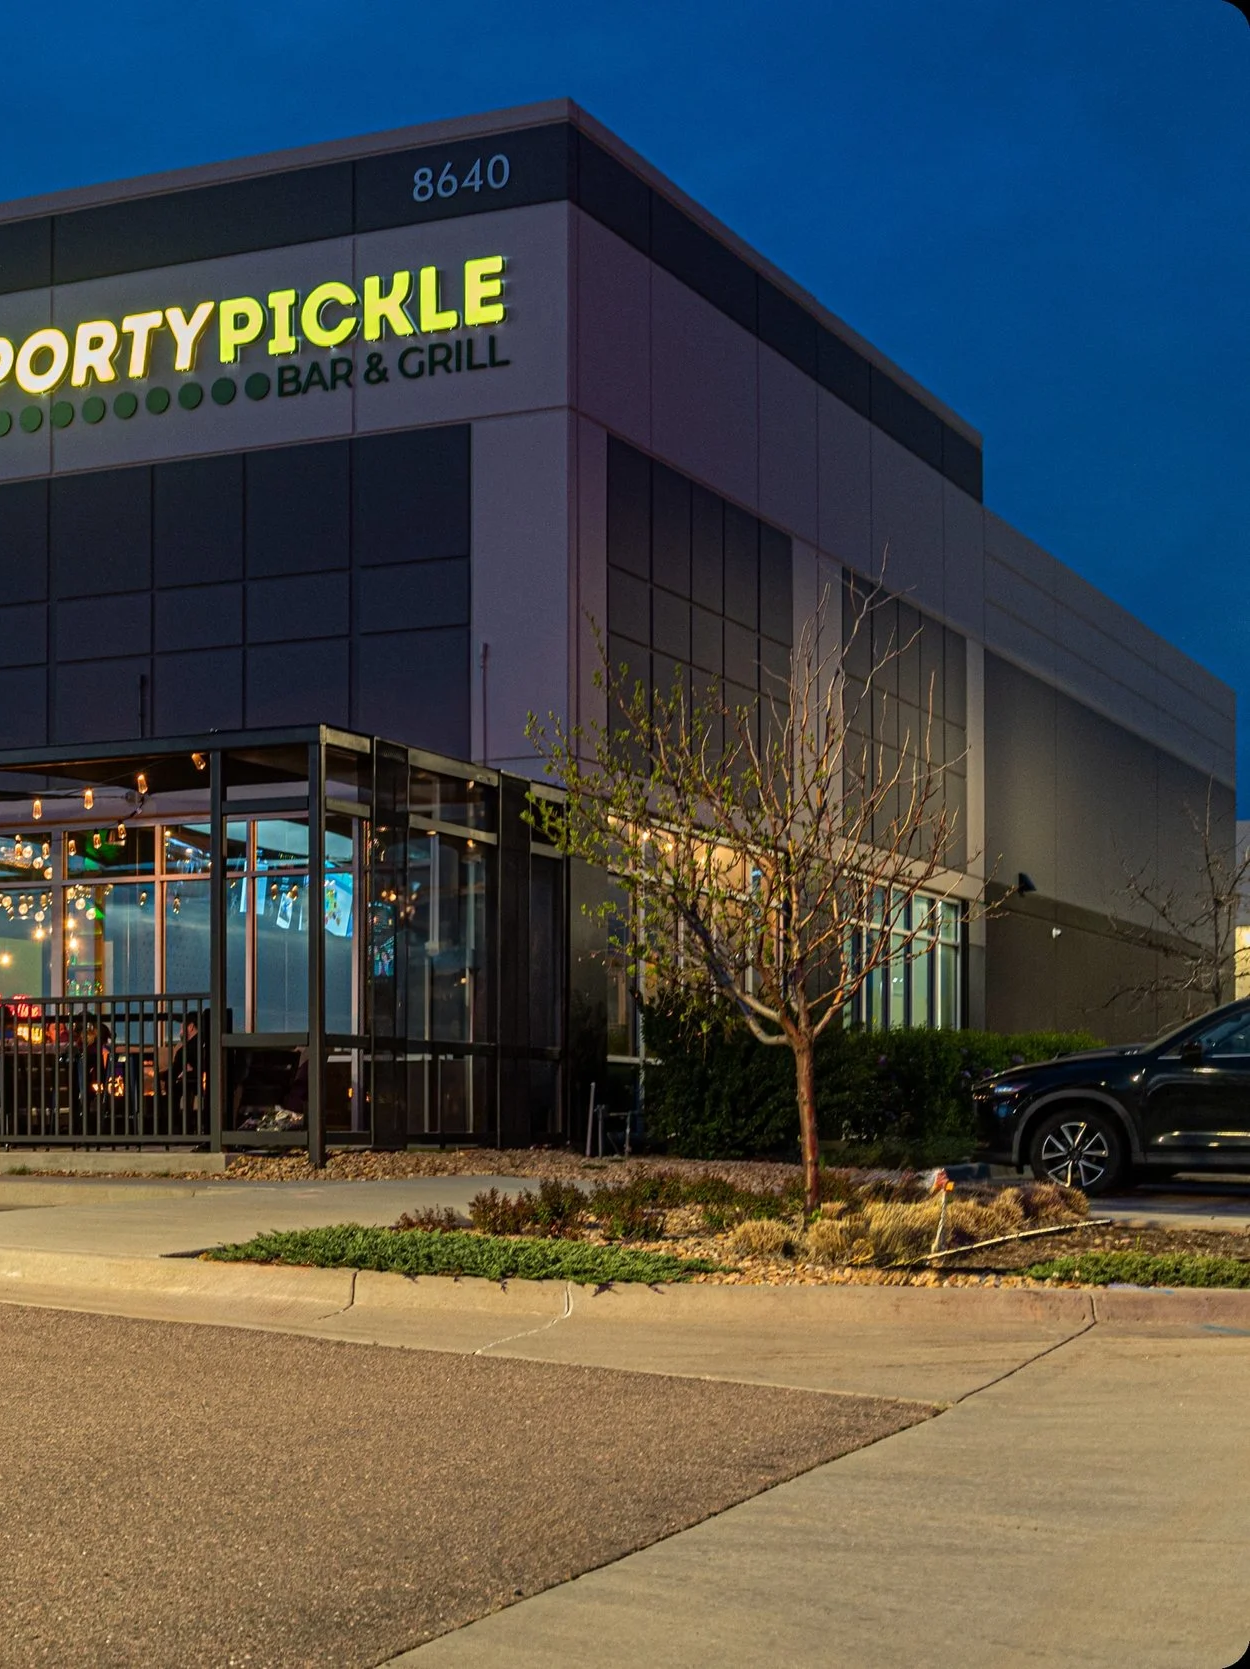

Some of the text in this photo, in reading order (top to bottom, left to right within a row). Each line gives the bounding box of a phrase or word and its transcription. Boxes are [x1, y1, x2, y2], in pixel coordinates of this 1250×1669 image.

[413, 154, 510, 202] 8640
[277, 335, 511, 398] BAR & GRILL
